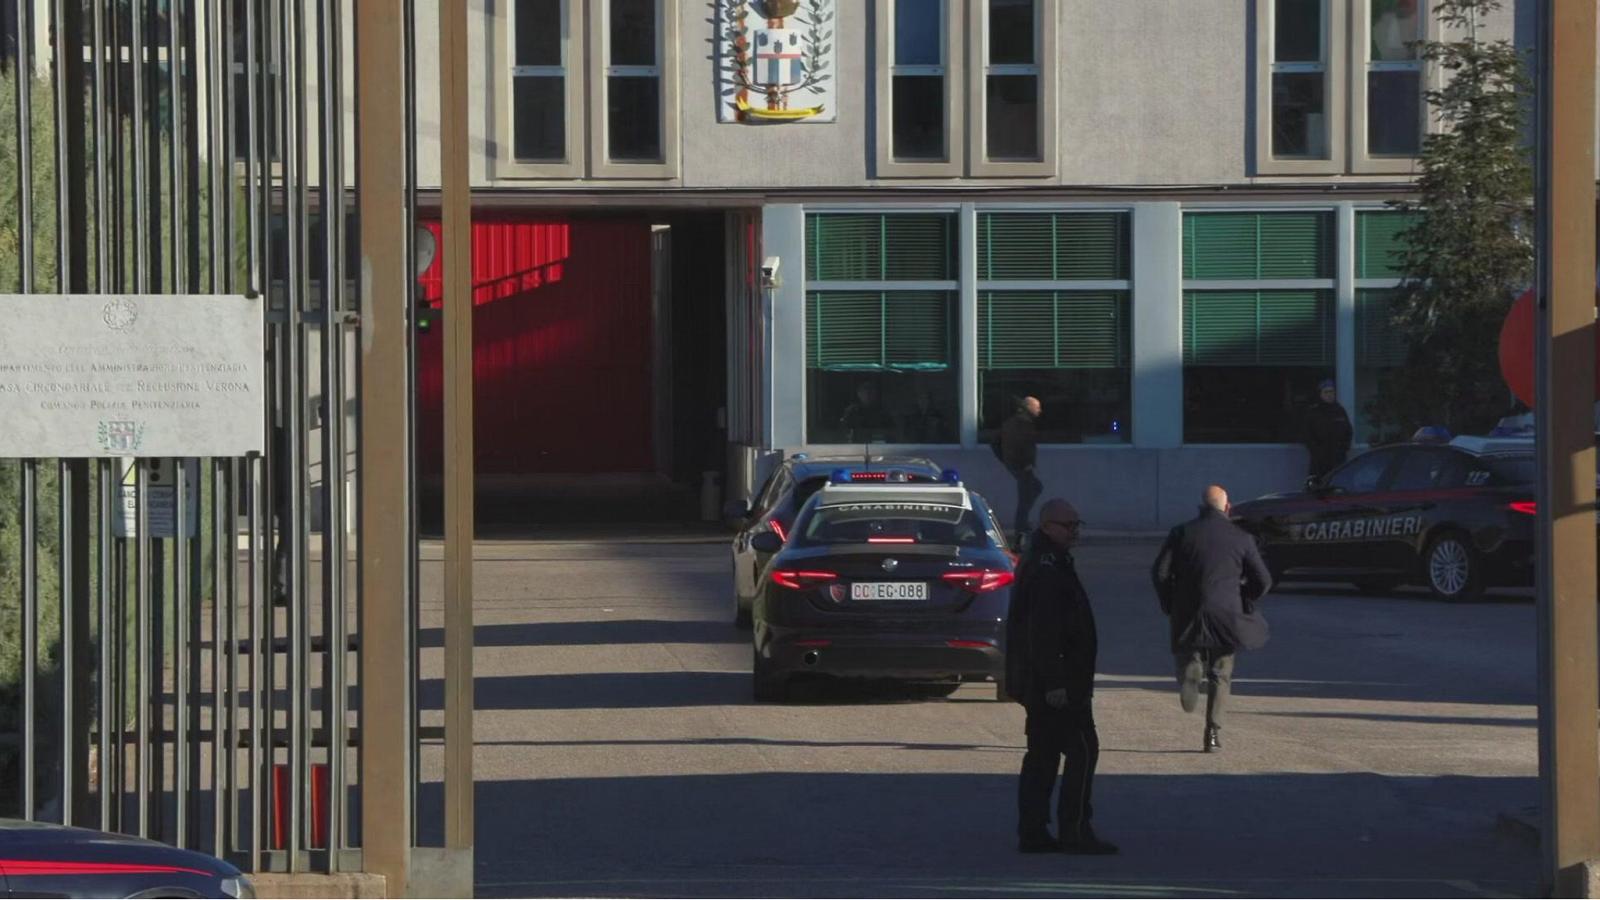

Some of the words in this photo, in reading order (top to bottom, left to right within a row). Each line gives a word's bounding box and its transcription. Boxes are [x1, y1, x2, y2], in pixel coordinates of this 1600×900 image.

[137, 380, 200, 392] RECLUSIONE
[206, 380, 250, 392] VERONA
[838, 504, 950, 513] CARABINIERI
[1304, 516, 1422, 541] CARABINIERI
